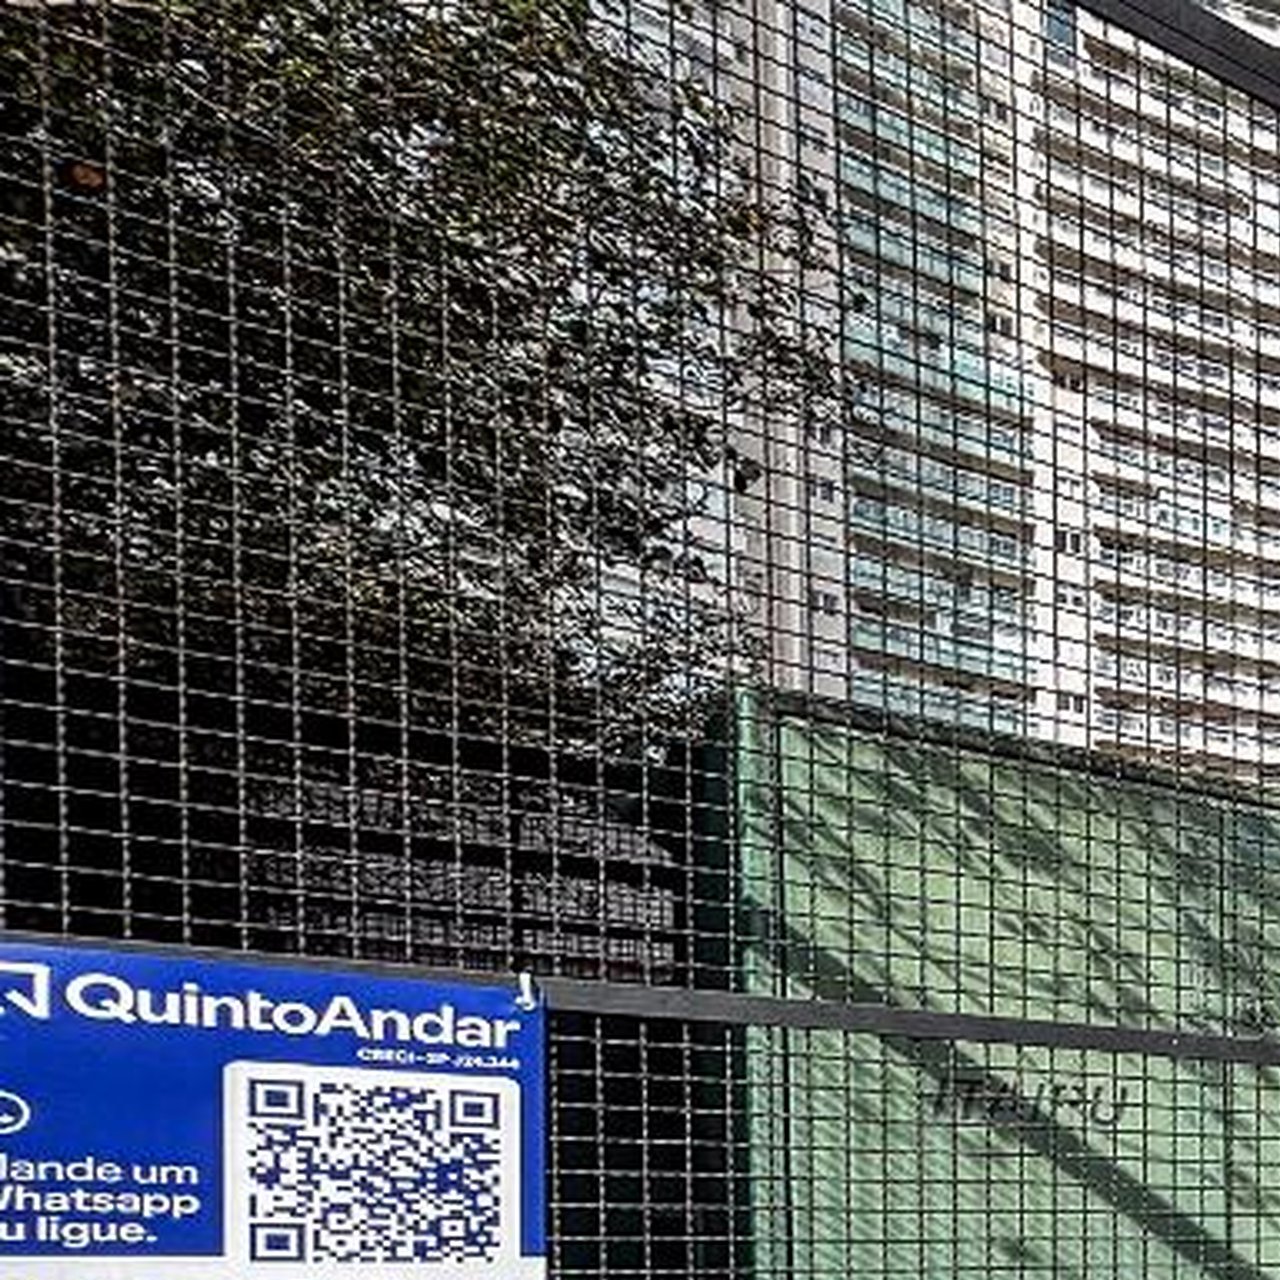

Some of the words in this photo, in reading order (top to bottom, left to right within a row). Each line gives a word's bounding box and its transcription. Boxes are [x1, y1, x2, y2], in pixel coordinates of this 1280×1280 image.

[66, 973, 520, 1048] QuintoAndar
[0, 1154, 122, 1183] ande
[132, 1163, 199, 1185] um
[37, 1215, 158, 1248] ligue.
